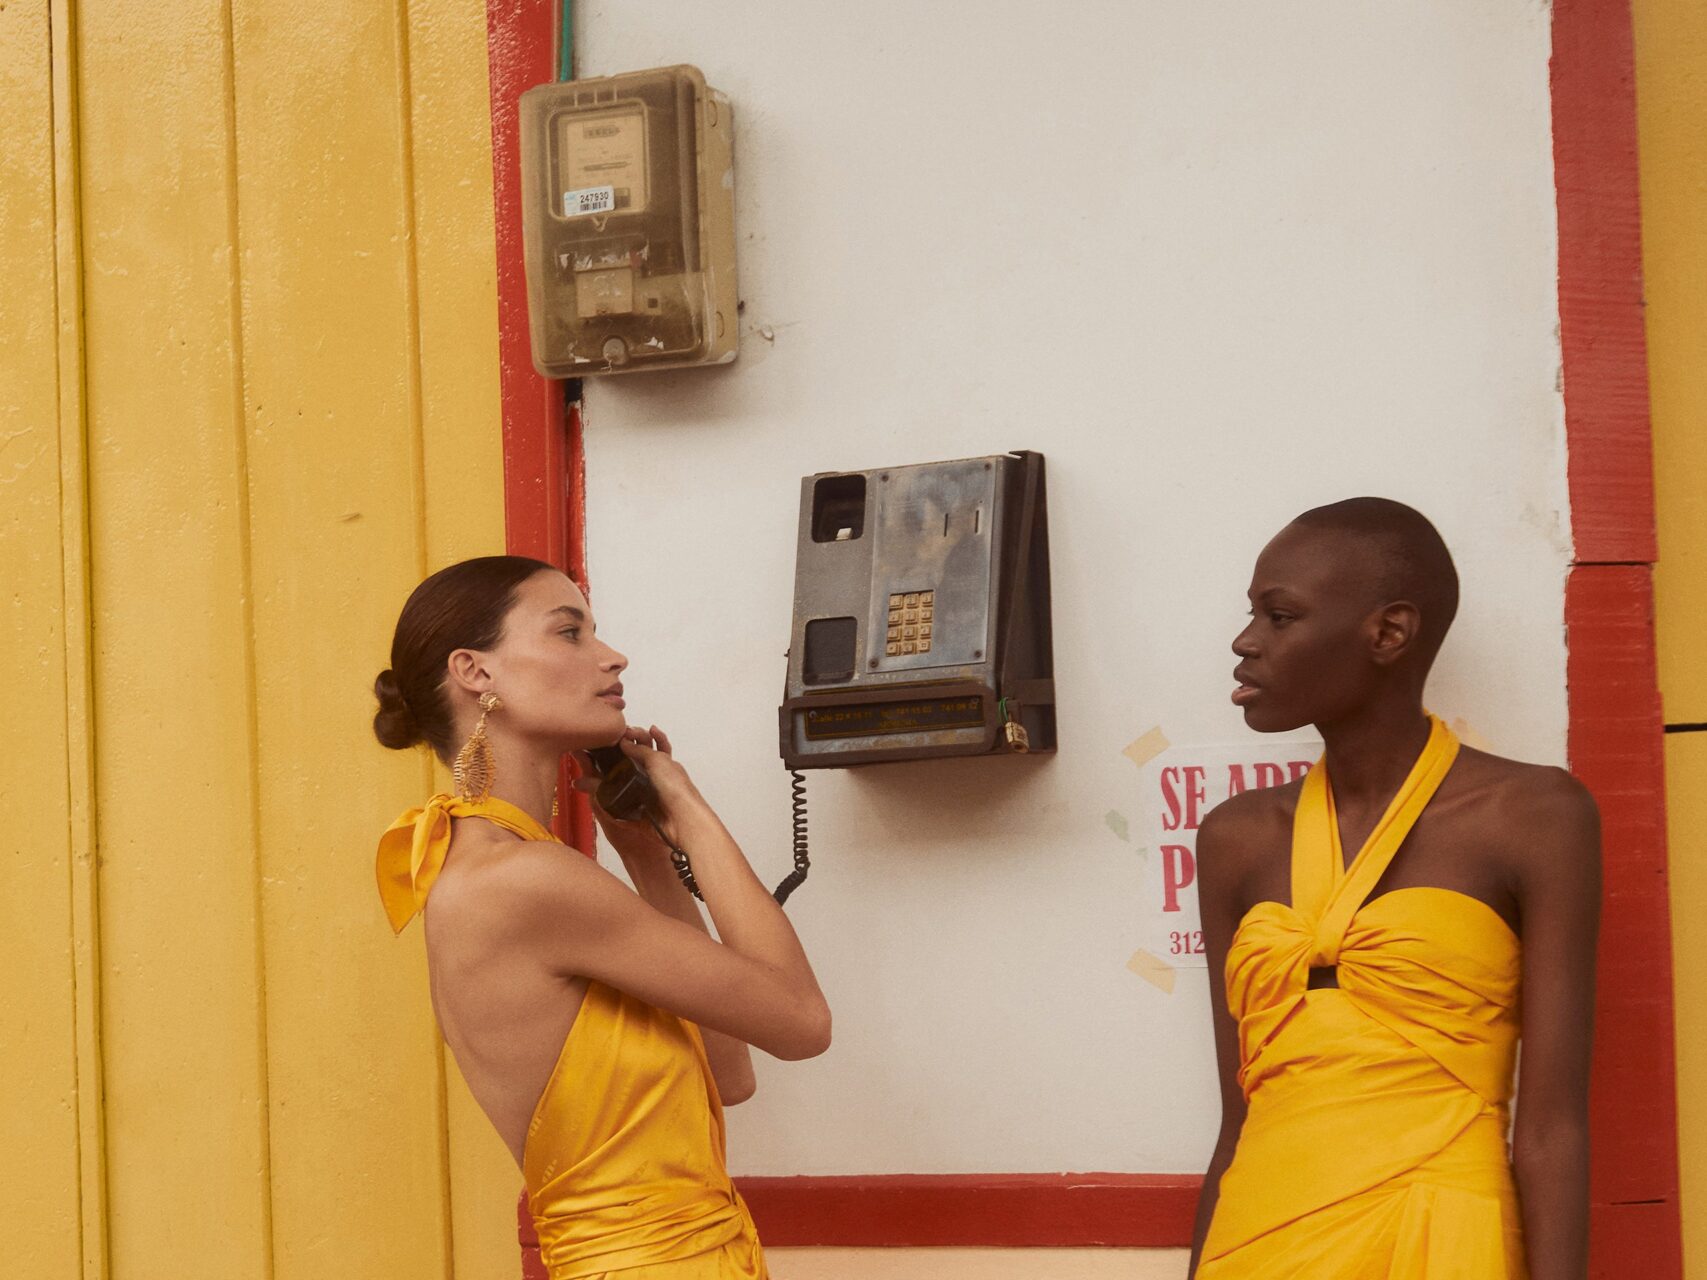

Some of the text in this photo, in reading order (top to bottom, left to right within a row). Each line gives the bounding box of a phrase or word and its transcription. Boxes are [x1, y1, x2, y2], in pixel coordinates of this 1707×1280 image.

[580, 191, 609, 203] 247930
[1160, 765, 1207, 831] SE
[1170, 930, 1206, 955] 312
